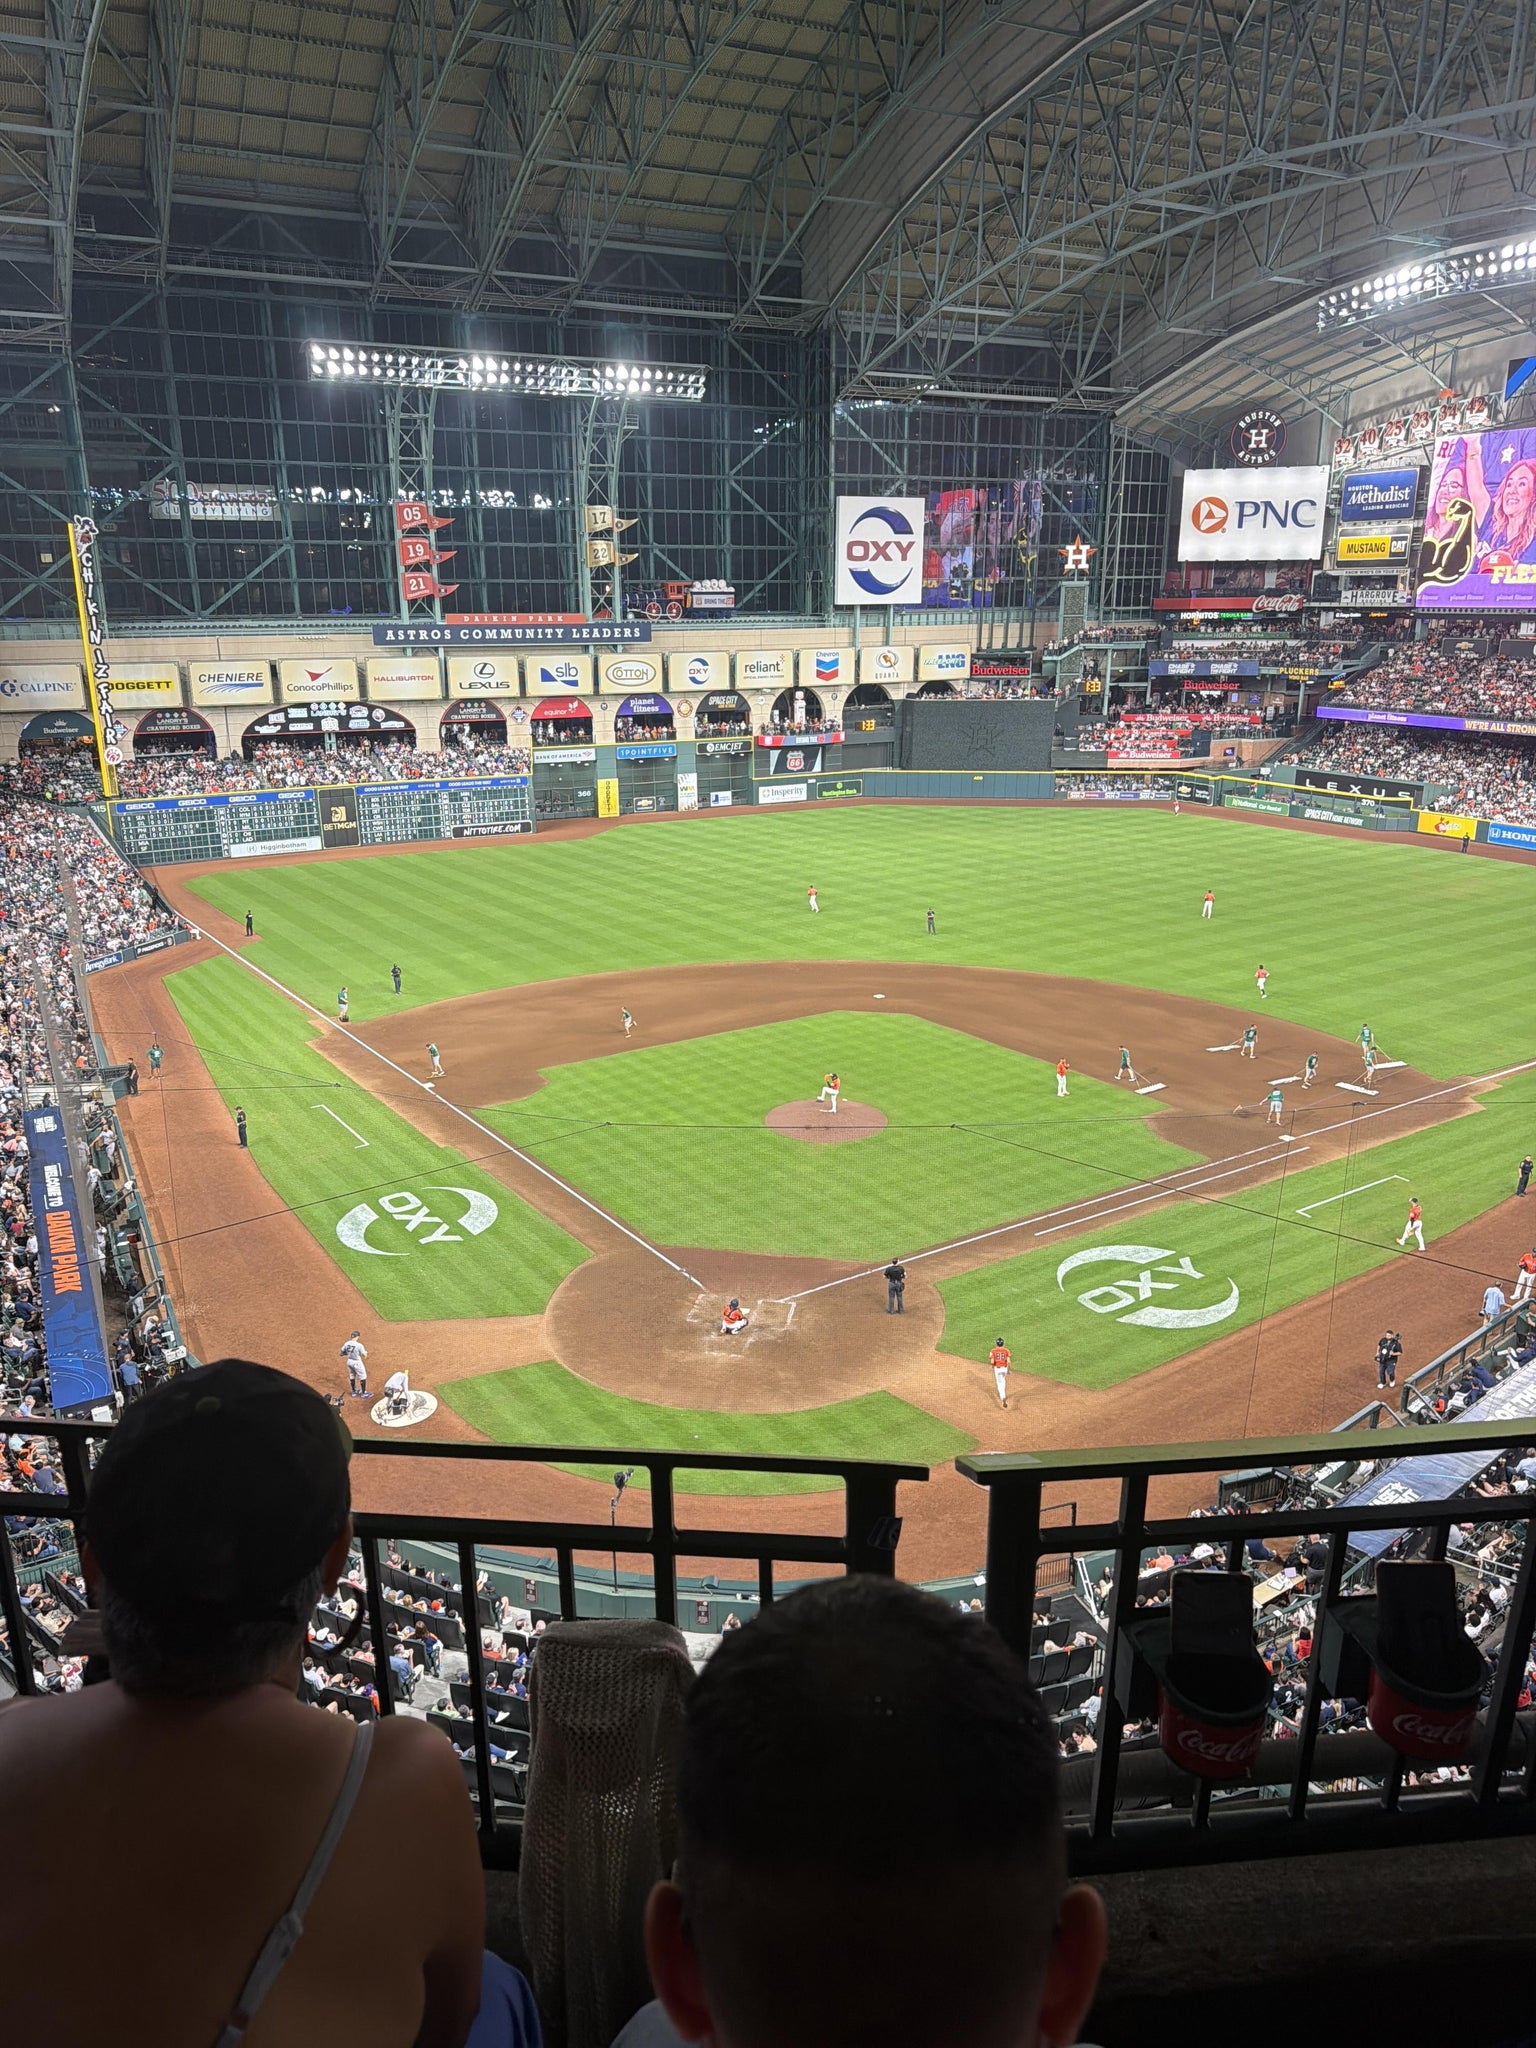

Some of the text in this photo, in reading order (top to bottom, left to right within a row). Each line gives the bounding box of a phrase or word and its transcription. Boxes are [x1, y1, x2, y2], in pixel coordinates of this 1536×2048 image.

[1467, 396, 1486, 414] 42
[1239, 411, 1281, 428] HOUSTON
[1412, 411, 1429, 428] 33
[1385, 420, 1403, 437] 25
[1248, 429, 1269, 449] H
[1360, 429, 1377, 445] 40
[1335, 438, 1351, 454] 32
[1238, 449, 1276, 464] ASTROS
[1347, 486, 1410, 505] Methodist
[165, 506, 270, 516] LUURY LIVING
[403, 507, 421, 521] 05
[1234, 499, 1317, 529] PNC
[591, 511, 607, 525] 17
[407, 543, 424, 558] 19
[846, 540, 916, 562] OXY
[1346, 540, 1407, 554] MUSTANG CAT
[593, 548, 607, 560] 22
[1065, 545, 1090, 569] H
[1490, 563, 1536, 584] FLE
[409, 578, 426, 591] 21
[1350, 591, 1399, 604] HARGROVE
[1180, 611, 1220, 620] HORNITOS
[385, 627, 641, 641] ASTROS COMMUNITY LEADERS
[745, 660, 781, 673] reliant
[938, 653, 965, 669] LNG
[556, 662, 578, 678] slb
[612, 665, 649, 680] COTTON
[688, 667, 709, 675] OXY
[875, 672, 900, 680] QUANTA
[971, 664, 1030, 676] Budweiser
[1279, 667, 1319, 676] PLUCKERS
[198, 673, 263, 683] CHENIERE
[373, 673, 434, 683] HALLIBURTON
[20, 682, 74, 692] CALPINE
[286, 682, 353, 692] ConocoPhillips
[459, 681, 510, 690] LEXUS
[1183, 679, 1241, 690] Budweiser
[630, 697, 654, 706] planet
[709, 695, 738, 705] SPACE CITY
[633, 705, 659, 713] fitness
[1146, 714, 1189, 722] Budweiser
[43, 727, 79, 735] Budweiser
[1465, 720, 1489, 730] WE'RE
[1490, 722, 1504, 731] ALL
[620, 746, 673, 756] 1POINTFIVE
[714, 742, 743, 753] EMCJET
[1128, 751, 1172, 759] Budweiser
[789, 759, 800, 767] 66
[771, 786, 803, 797] Insperity
[1305, 778, 1411, 798] LEXUS
[278, 791, 305, 799] GEICO
[125, 802, 155, 810] GEICO
[178, 798, 207, 806] GEICO
[1361, 798, 1376, 807] 370
[91, 805, 107, 813] 315
[1304, 808, 1321, 820] SPACE
[1320, 810, 1334, 821] CITY
[323, 821, 357, 831] BETMGM
[463, 824, 522, 837] NITTOTIRE.COM
[260, 842, 307, 850] Higginbotham
[85, 954, 119, 972] AmegyBank
[44, 1164, 64, 1207] WELCOME TO
[378, 1191, 464, 1245] OXY
[46, 1211, 83, 1295] DAIKIN PARK
[1077, 1256, 1206, 1314] OXY
[347, 1344, 355, 1353] 27
[1285, 1690, 1292, 1701] 2
